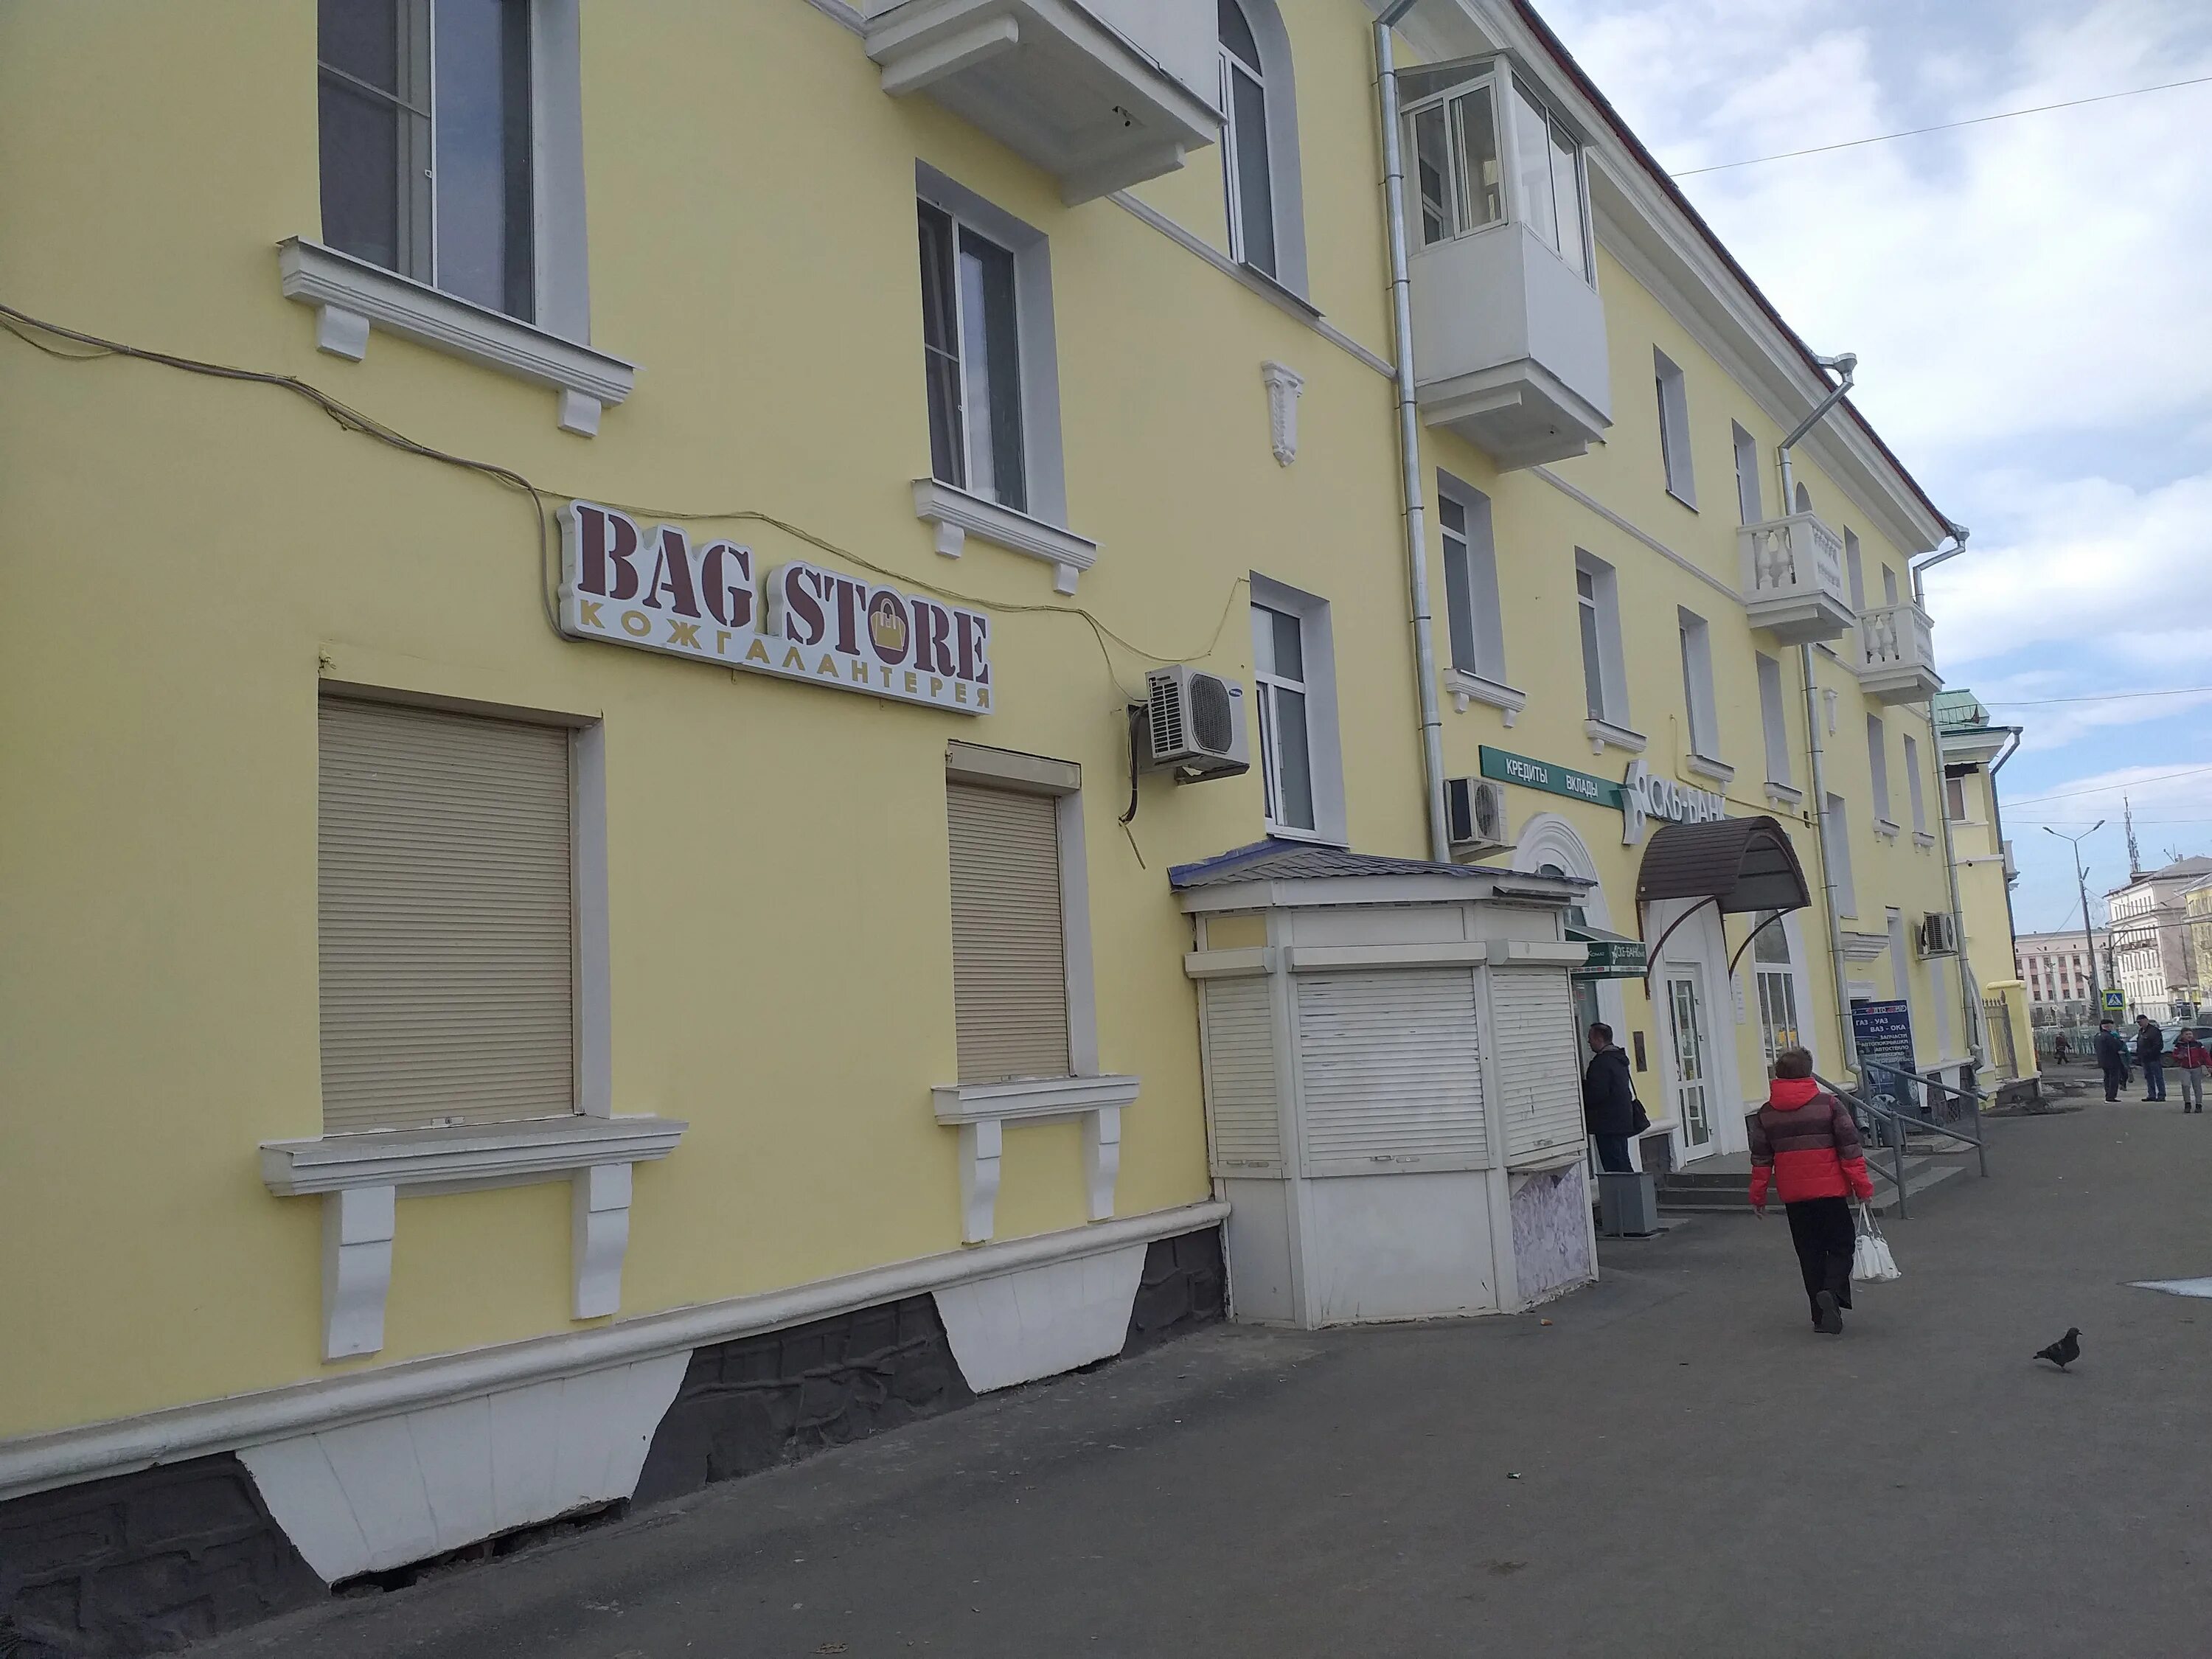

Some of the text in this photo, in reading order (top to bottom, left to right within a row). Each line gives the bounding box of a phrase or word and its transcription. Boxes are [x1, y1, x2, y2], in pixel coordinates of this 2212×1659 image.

[576, 505, 990, 685] BAG STORE
[580, 599, 990, 709] КОЖГАЛАНТЕРЕЯ
[1506, 758, 1599, 798] КРЕДИТЫ ВКЛАДЫ
